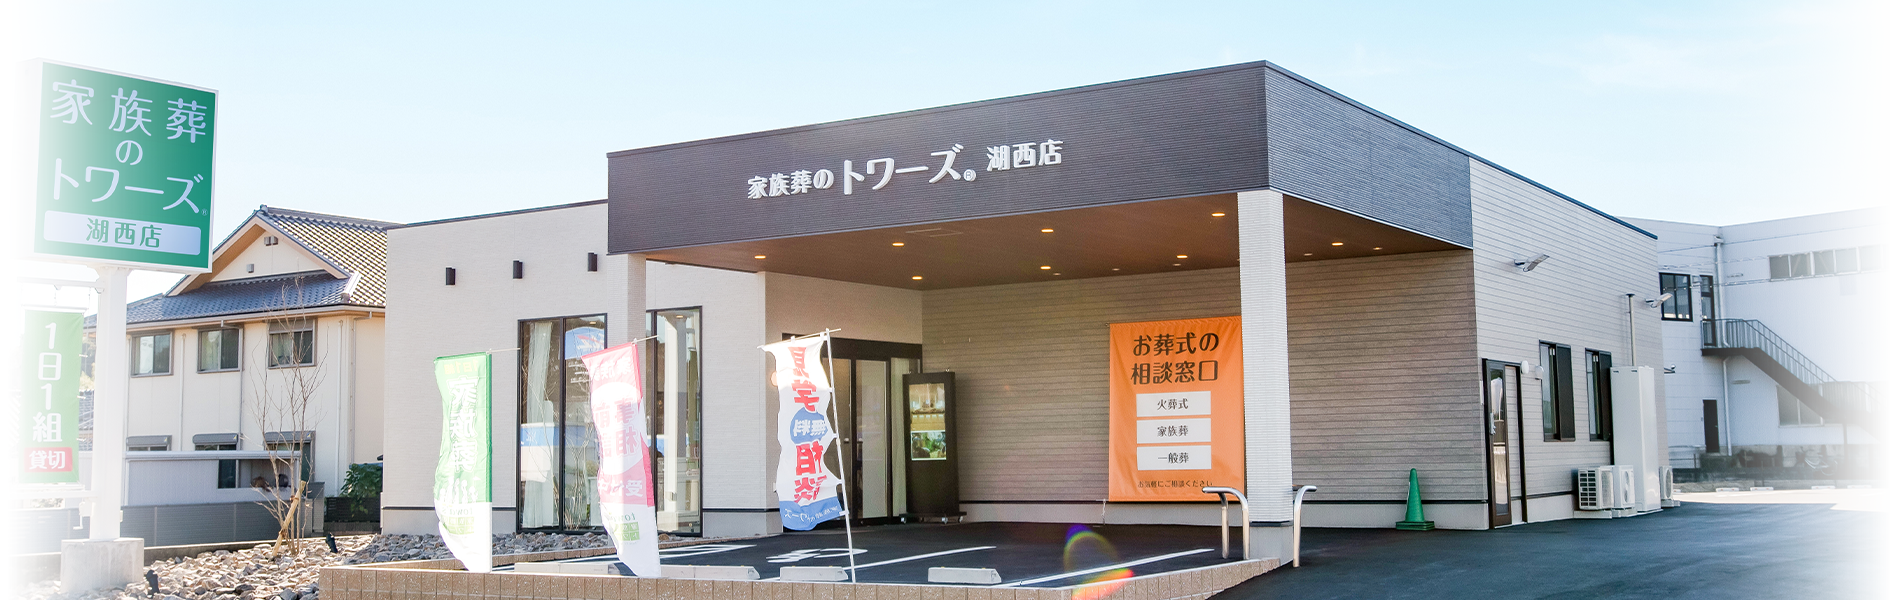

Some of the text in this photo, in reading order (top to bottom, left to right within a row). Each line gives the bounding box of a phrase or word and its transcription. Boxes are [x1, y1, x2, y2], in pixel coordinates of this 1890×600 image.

[50, 79, 208, 143] 家族葬
[115, 139, 143, 166] の
[747, 168, 834, 199] 家族葬の
[986, 138, 1064, 171] 湖西店
[86, 218, 163, 248] 湖西店
[1133, 332, 1220, 357] お葬式の
[32, 322, 63, 443] 1日1組
[1130, 360, 1218, 385] 相談窓口
[1157, 398, 1189, 410] 火葬式
[1157, 425, 1189, 437] 家族葬
[28, 450, 66, 470] 貸切
[1157, 452, 1189, 464] 一般葬
